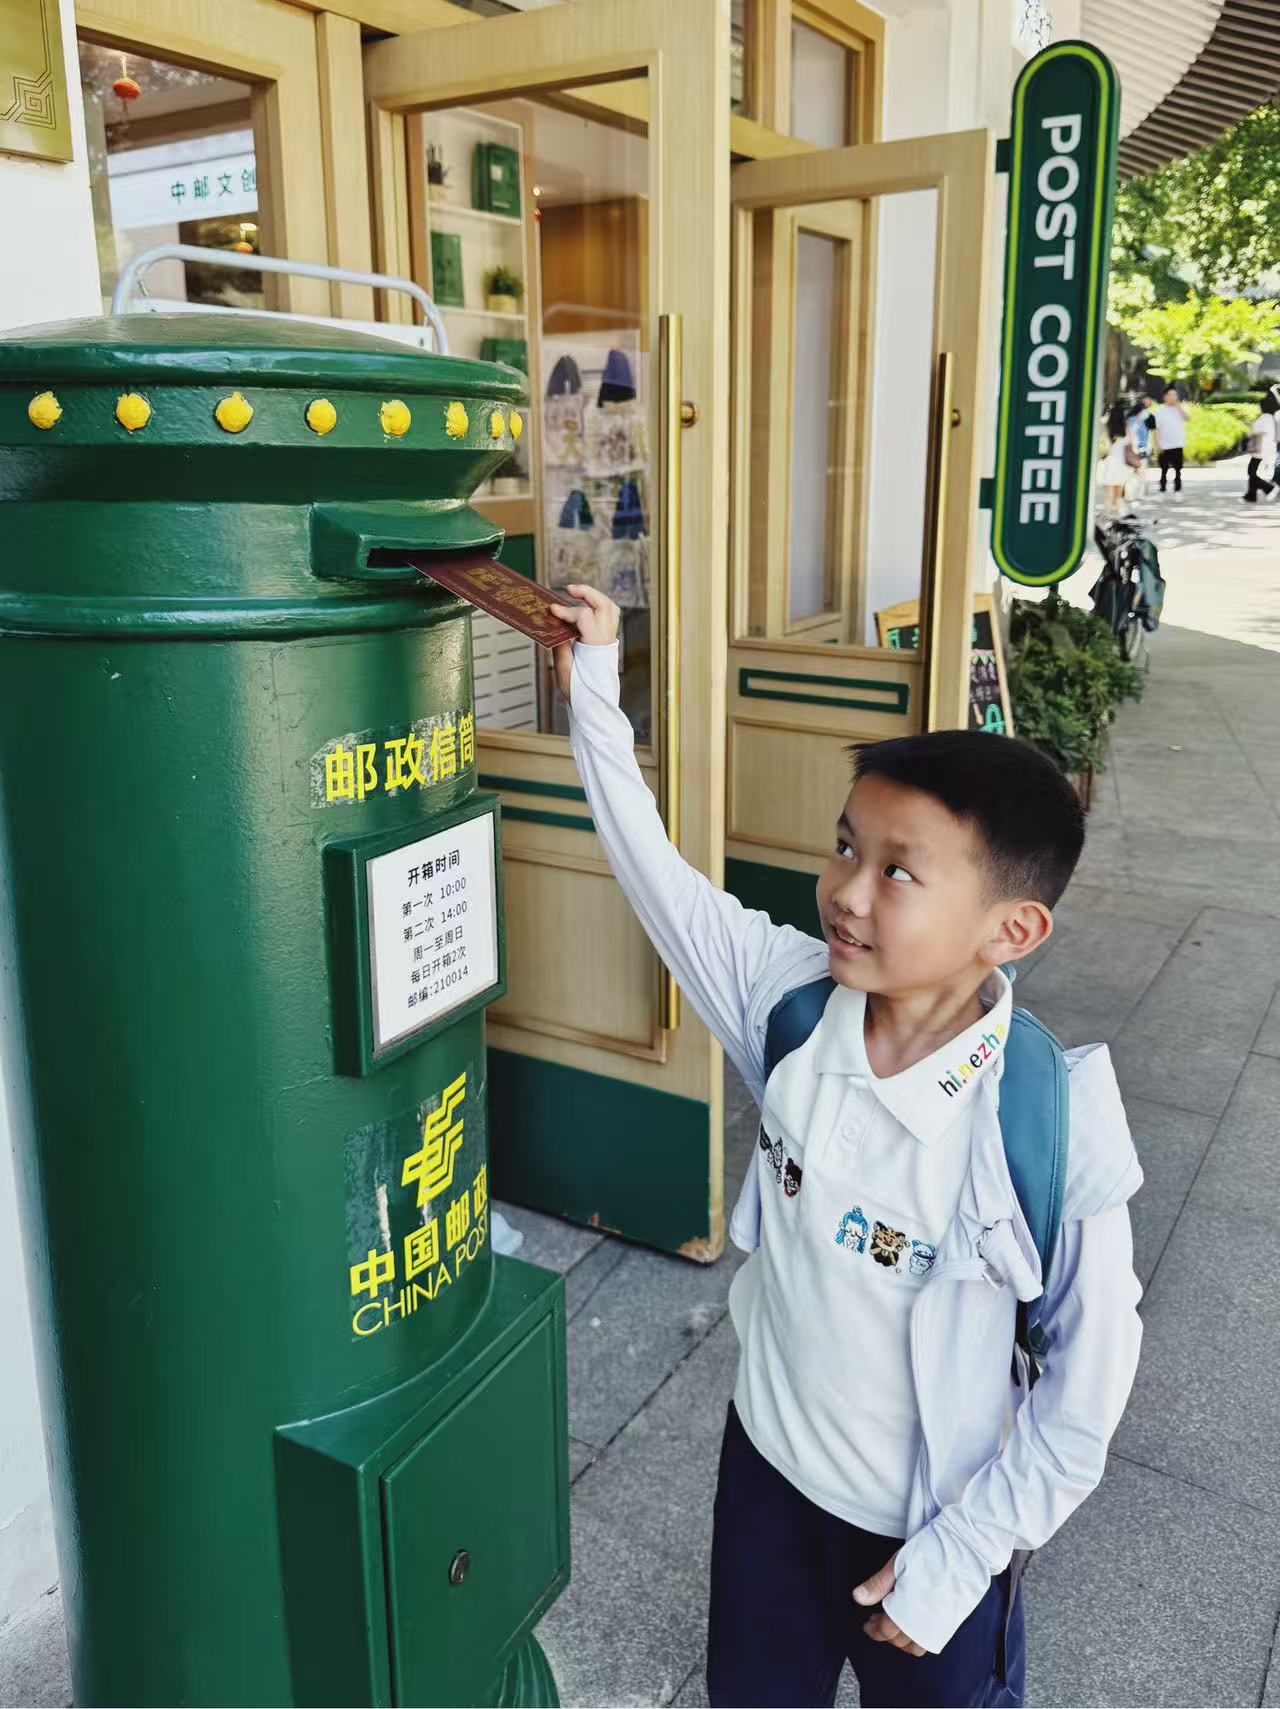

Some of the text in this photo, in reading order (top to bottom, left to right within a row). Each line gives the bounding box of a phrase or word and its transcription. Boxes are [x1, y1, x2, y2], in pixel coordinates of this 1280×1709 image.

[170, 168, 256, 205] 中邮文创
[1018, 113, 1082, 526] POST COFFEE
[325, 712, 474, 802] 邮政信筒
[407, 849, 460, 887] 开箱时间
[402, 877, 467, 918] 第一次 10:00
[403, 900, 467, 943] 第二次 14:00
[411, 946, 466, 984] 每日开箱2次
[413, 925, 463, 963] 周一至周日
[350, 1163, 487, 1299] 中国邮政
[352, 1261, 452, 1336] CHINA
